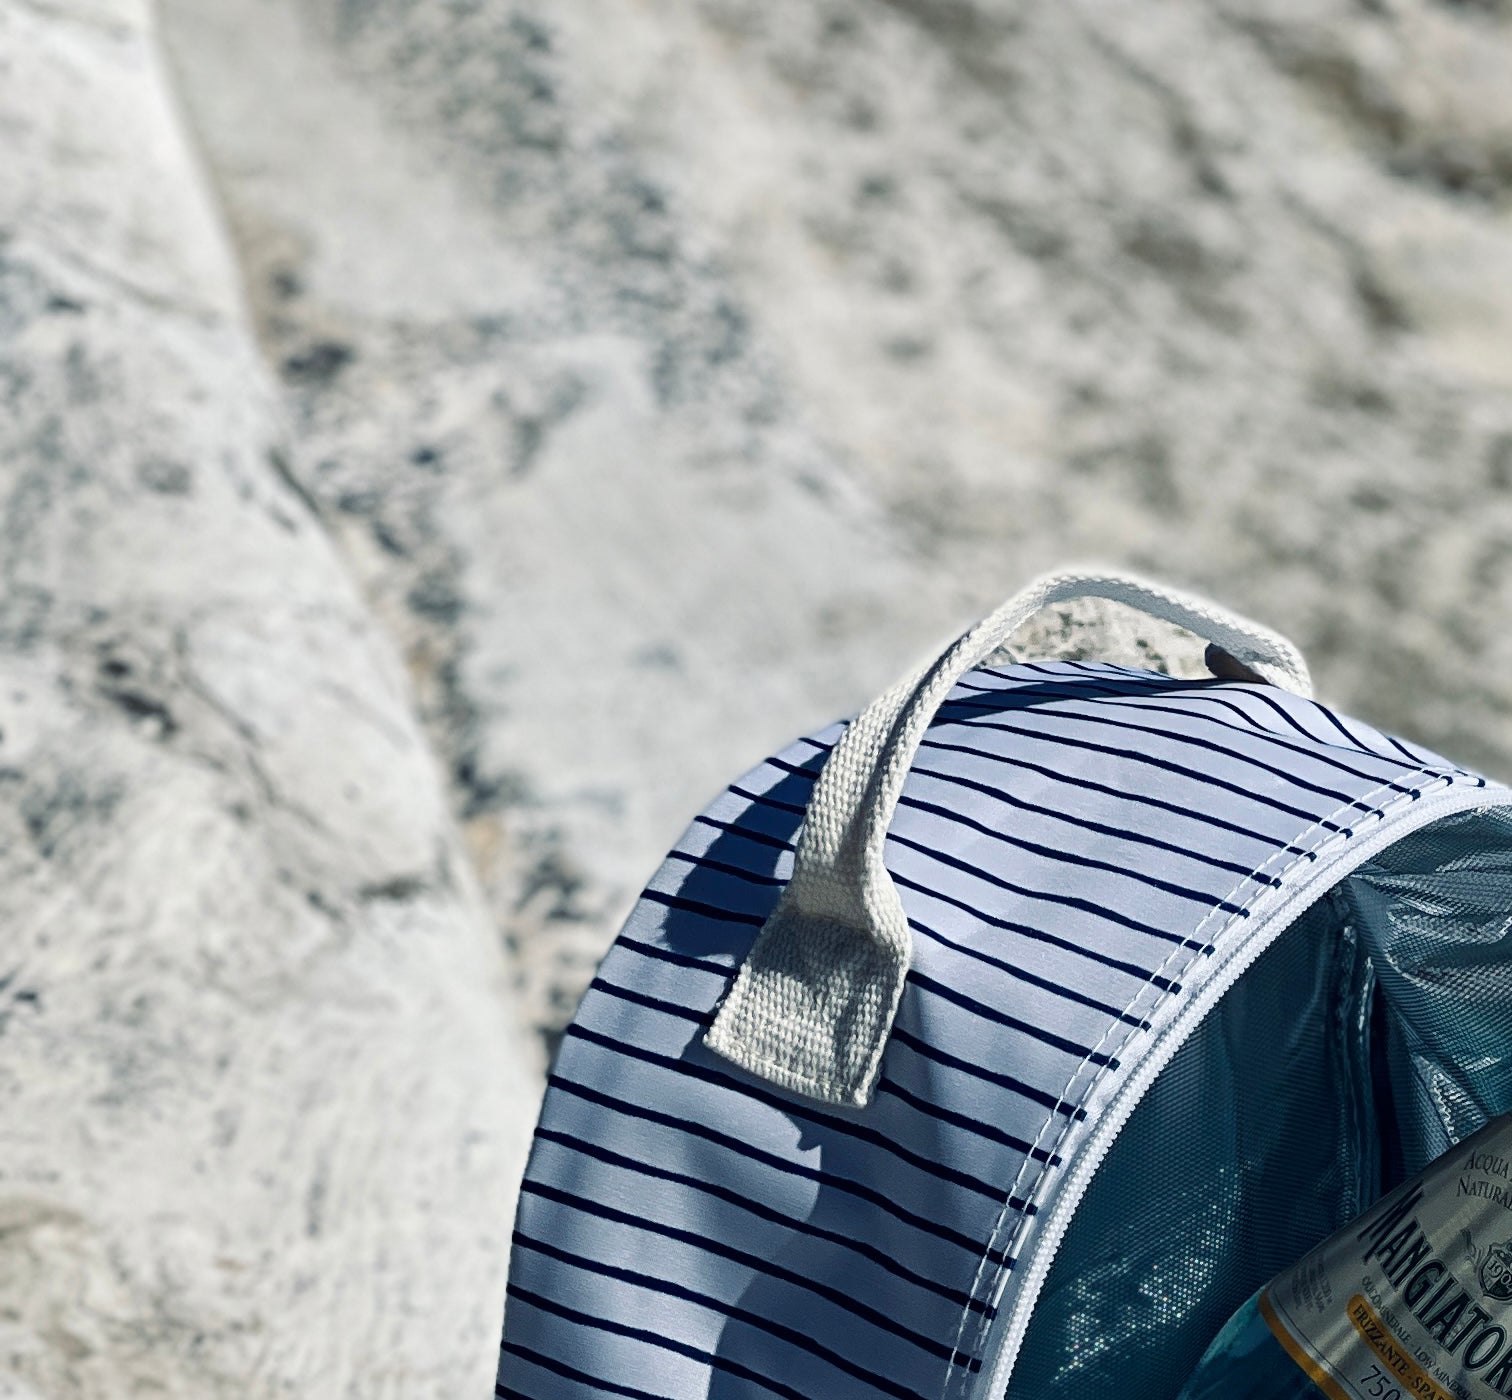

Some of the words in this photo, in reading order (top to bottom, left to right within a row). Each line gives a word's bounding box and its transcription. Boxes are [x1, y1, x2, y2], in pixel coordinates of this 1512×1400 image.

[1464, 1151, 1509, 1179] ACQUA
[1353, 1303, 1410, 1376] FRIZZANTE
[1413, 1346, 1437, 1371] LOW
